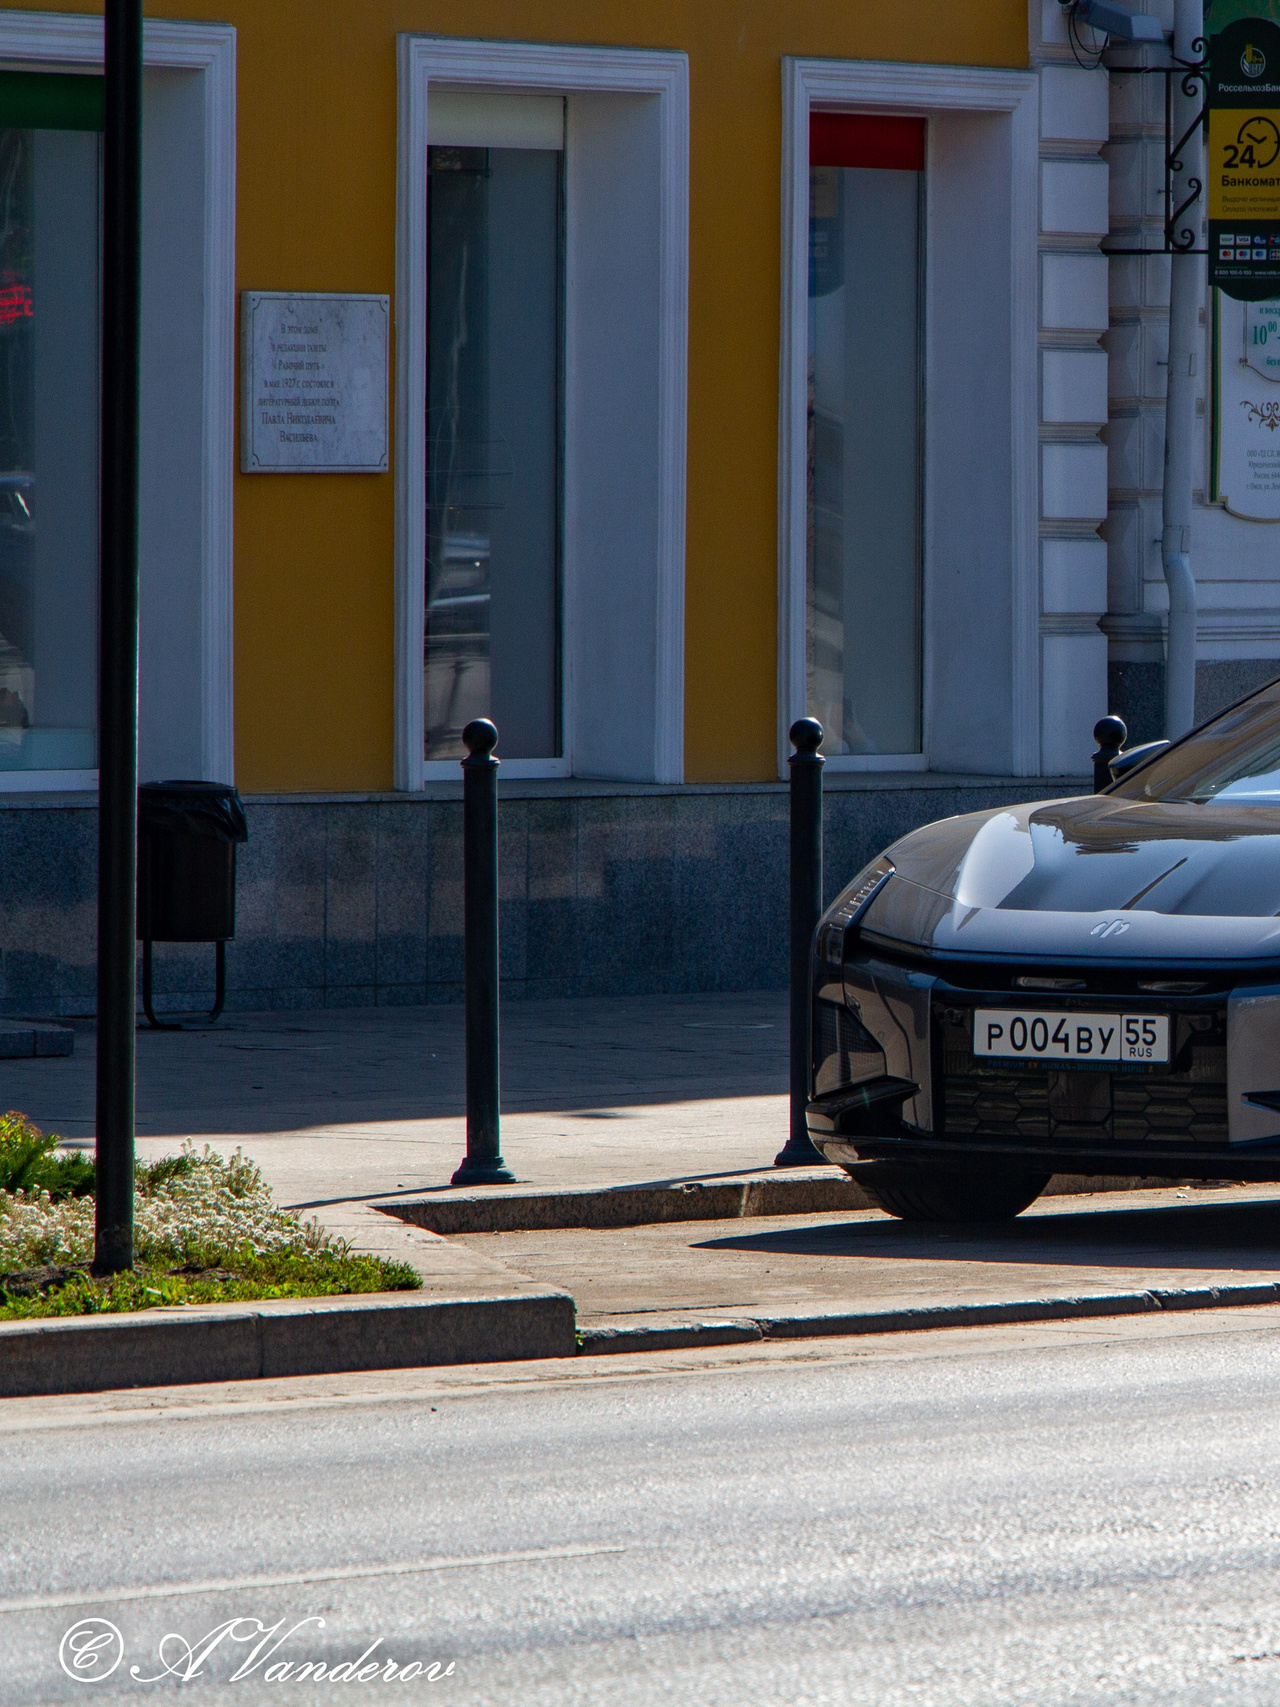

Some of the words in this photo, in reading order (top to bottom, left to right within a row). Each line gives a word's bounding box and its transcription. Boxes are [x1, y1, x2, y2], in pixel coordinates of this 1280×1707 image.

[1222, 145, 1256, 169] 24
[1221, 175, 1280, 187] Банкомат
[1221, 195, 1248, 203] Выдача
[1221, 205, 1246, 213] Оплата
[987, 1017, 1115, 1054] Р004ВУ
[1125, 1019, 1157, 1046] 55
[1129, 1047, 1153, 1058] RUS
[987, 1060, 1025, 1069] PREMIUM
[1028, 1061, 1039, 1069] EV
